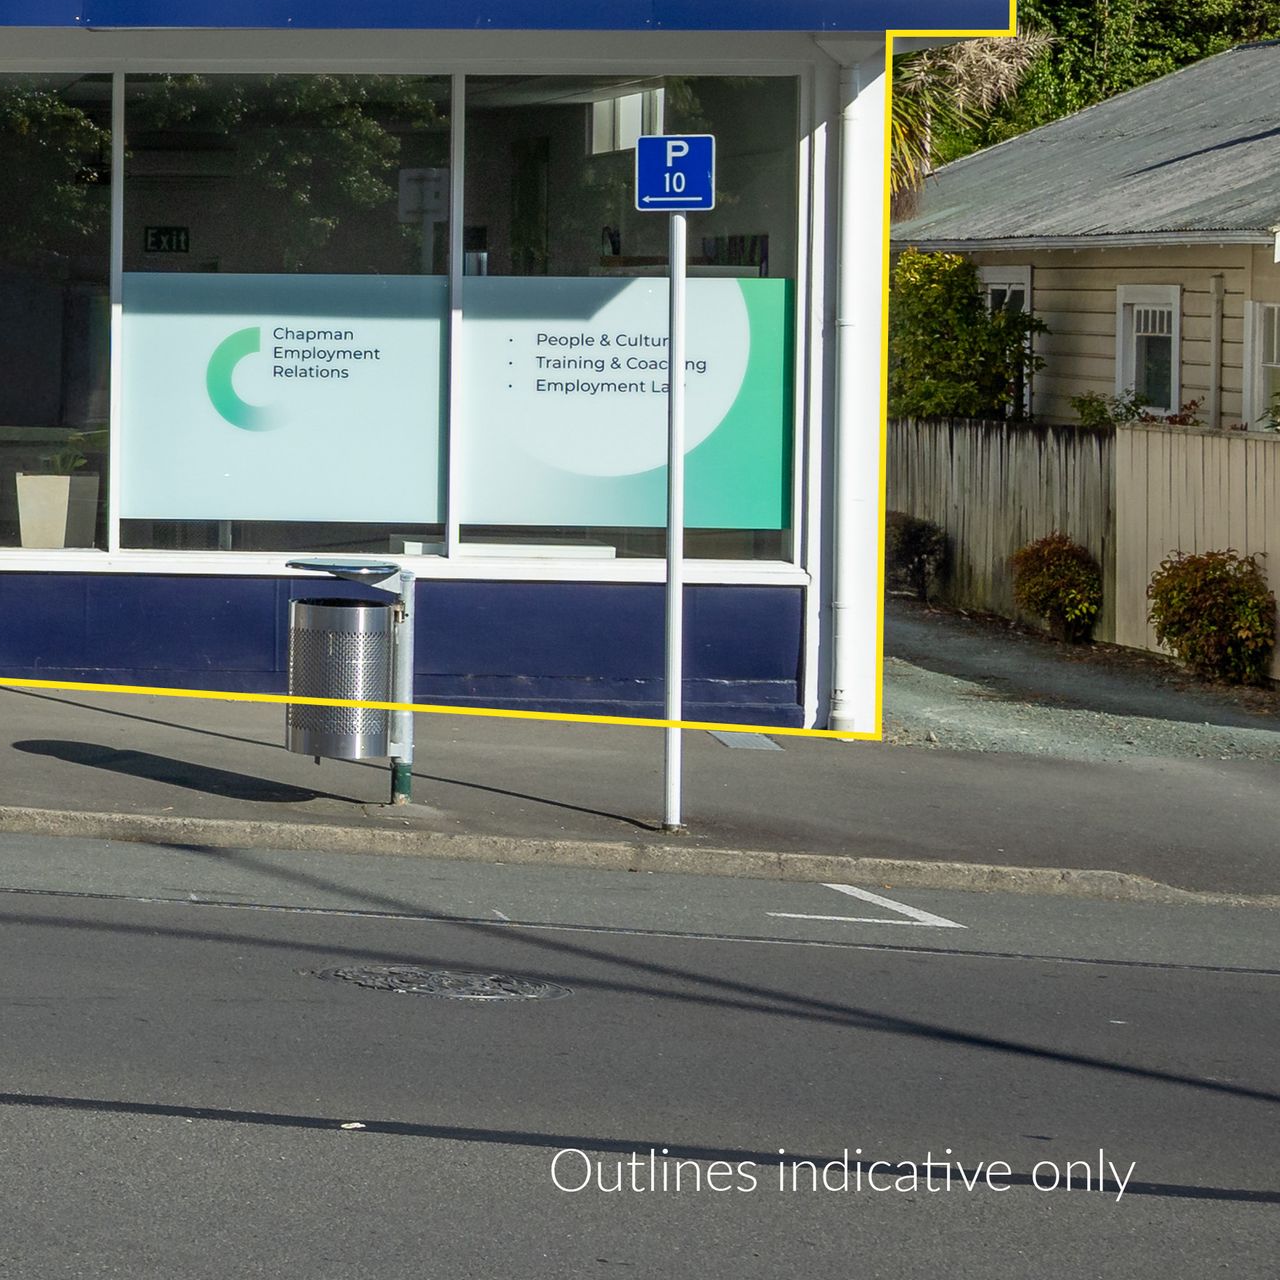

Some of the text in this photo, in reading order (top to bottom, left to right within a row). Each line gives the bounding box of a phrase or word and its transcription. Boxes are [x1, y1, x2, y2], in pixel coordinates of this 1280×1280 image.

[666, 140, 690, 167] P
[664, 171, 686, 193] 10
[147, 229, 187, 250] Exit
[273, 327, 354, 343] Chapman
[537, 333, 670, 349] People & Cultur
[273, 346, 381, 363] Employment
[273, 365, 349, 379] Relations
[536, 355, 707, 374] Training & Coacng
[536, 378, 646, 396] Employment
